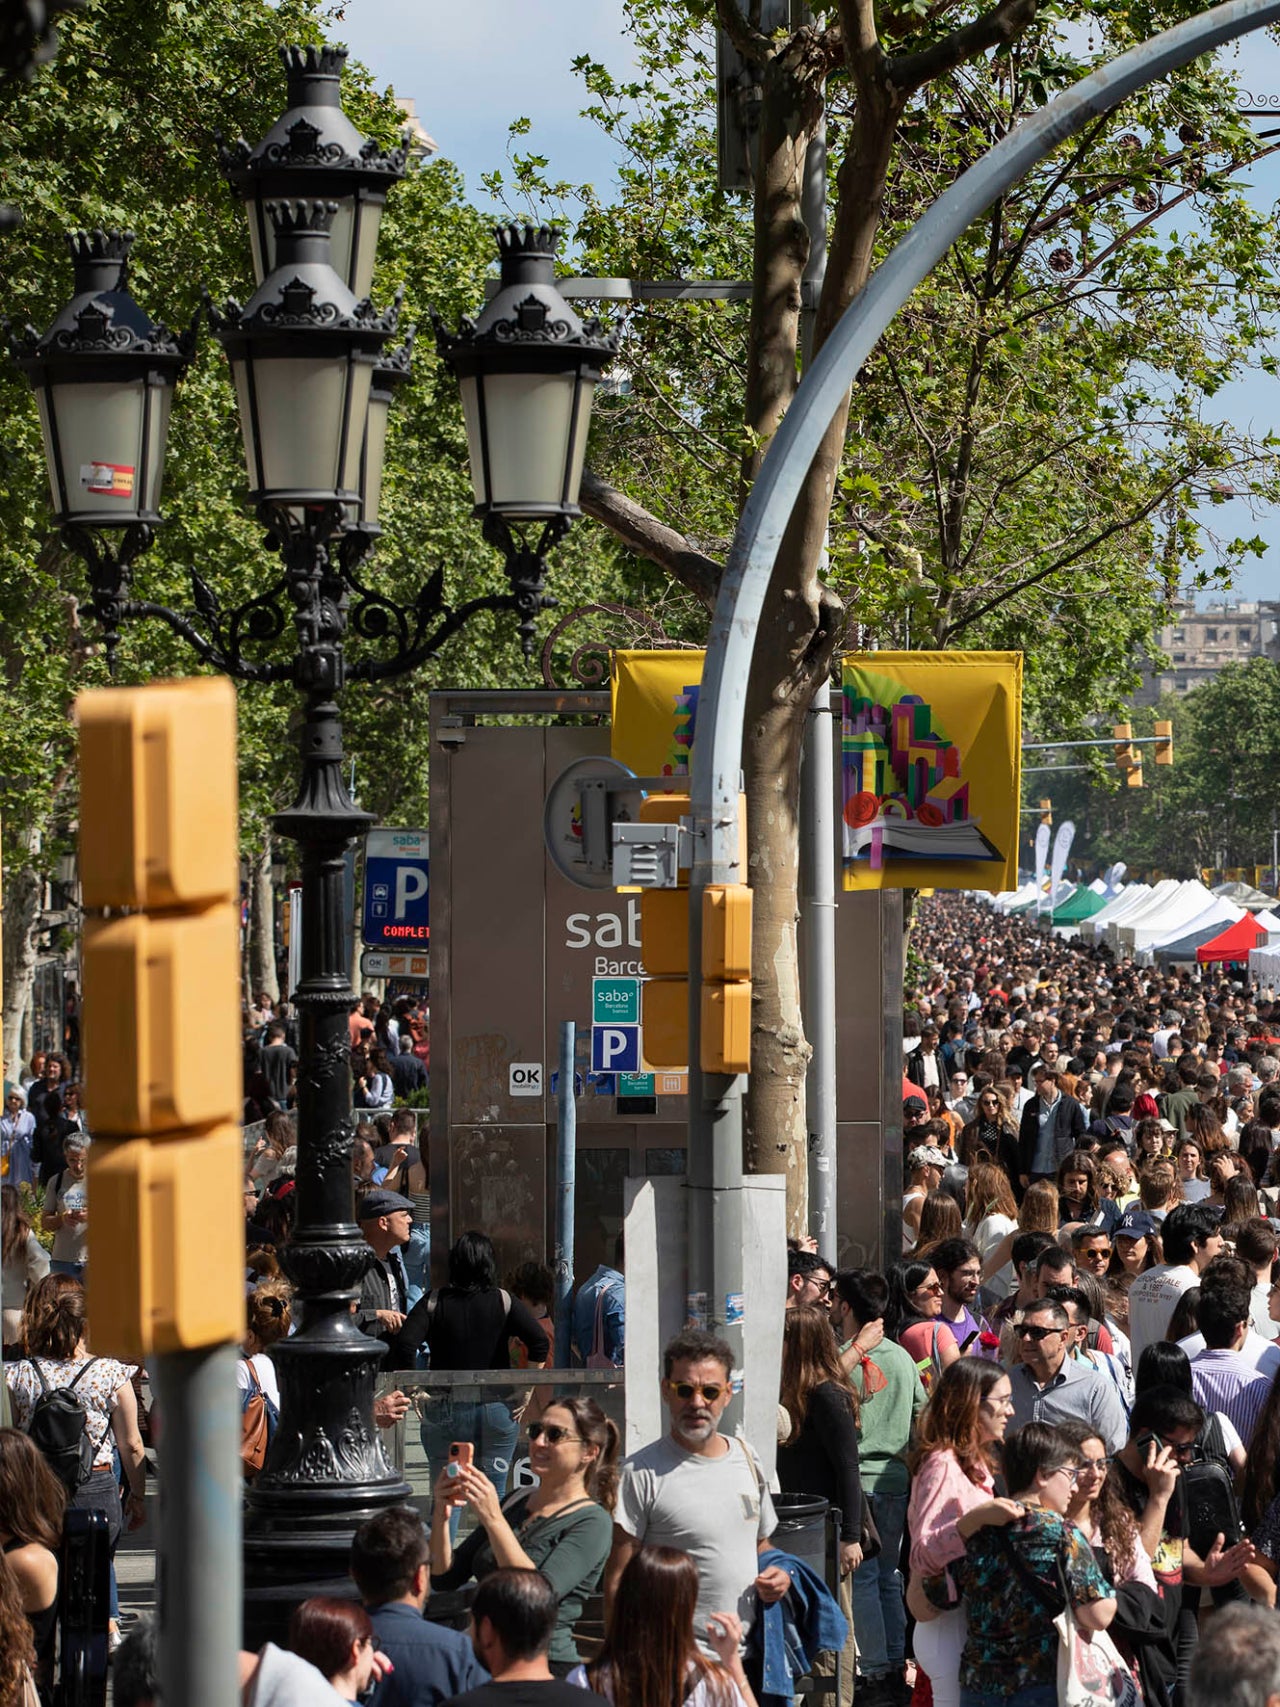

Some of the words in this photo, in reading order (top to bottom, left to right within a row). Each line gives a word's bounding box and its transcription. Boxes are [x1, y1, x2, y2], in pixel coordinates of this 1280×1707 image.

[394, 866, 430, 919] P
[597, 989, 629, 1002] saba
[602, 1029, 628, 1068] P
[512, 1069, 540, 1083] OK
